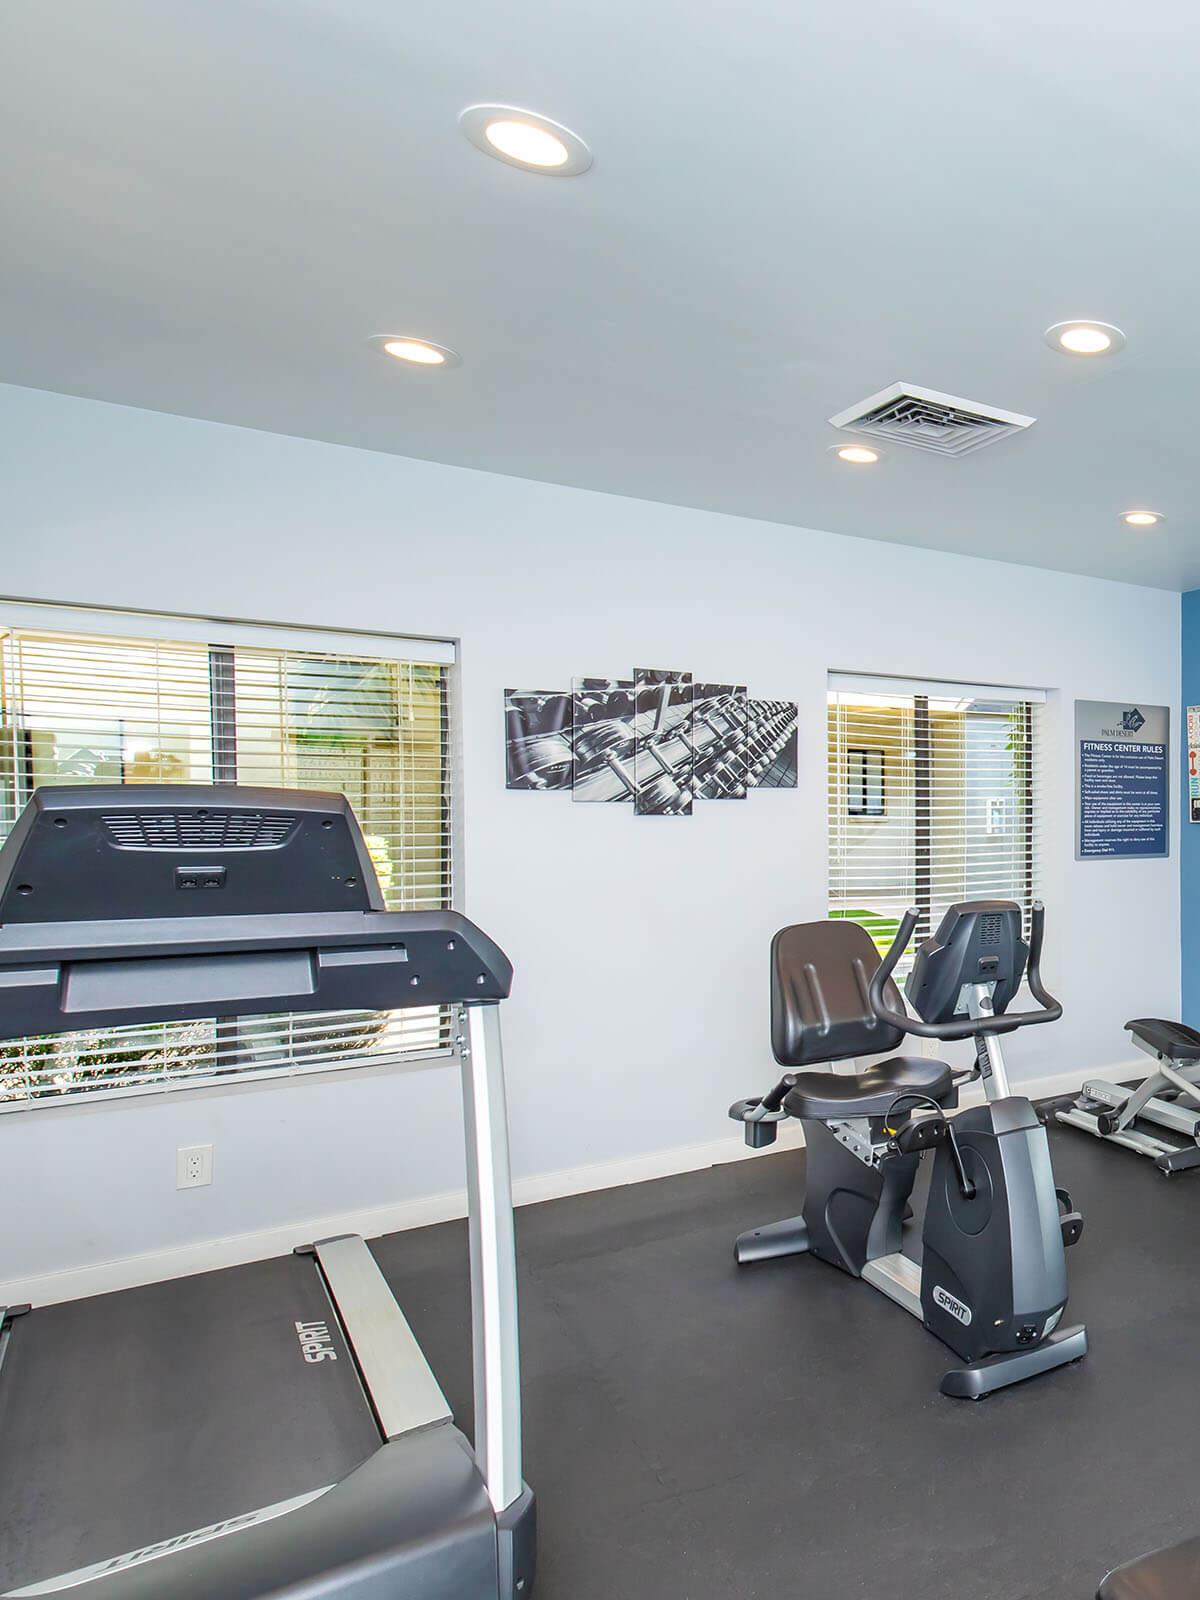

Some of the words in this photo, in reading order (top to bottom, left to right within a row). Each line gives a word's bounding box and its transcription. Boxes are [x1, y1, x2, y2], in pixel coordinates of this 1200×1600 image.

[1084, 742, 1113, 751] FITNESS
[1114, 744, 1141, 753] CENTER
[1142, 745, 1163, 753] RULES
[938, 1291, 967, 1320] SPIRIT
[295, 1321, 337, 1363] SPIRIT
